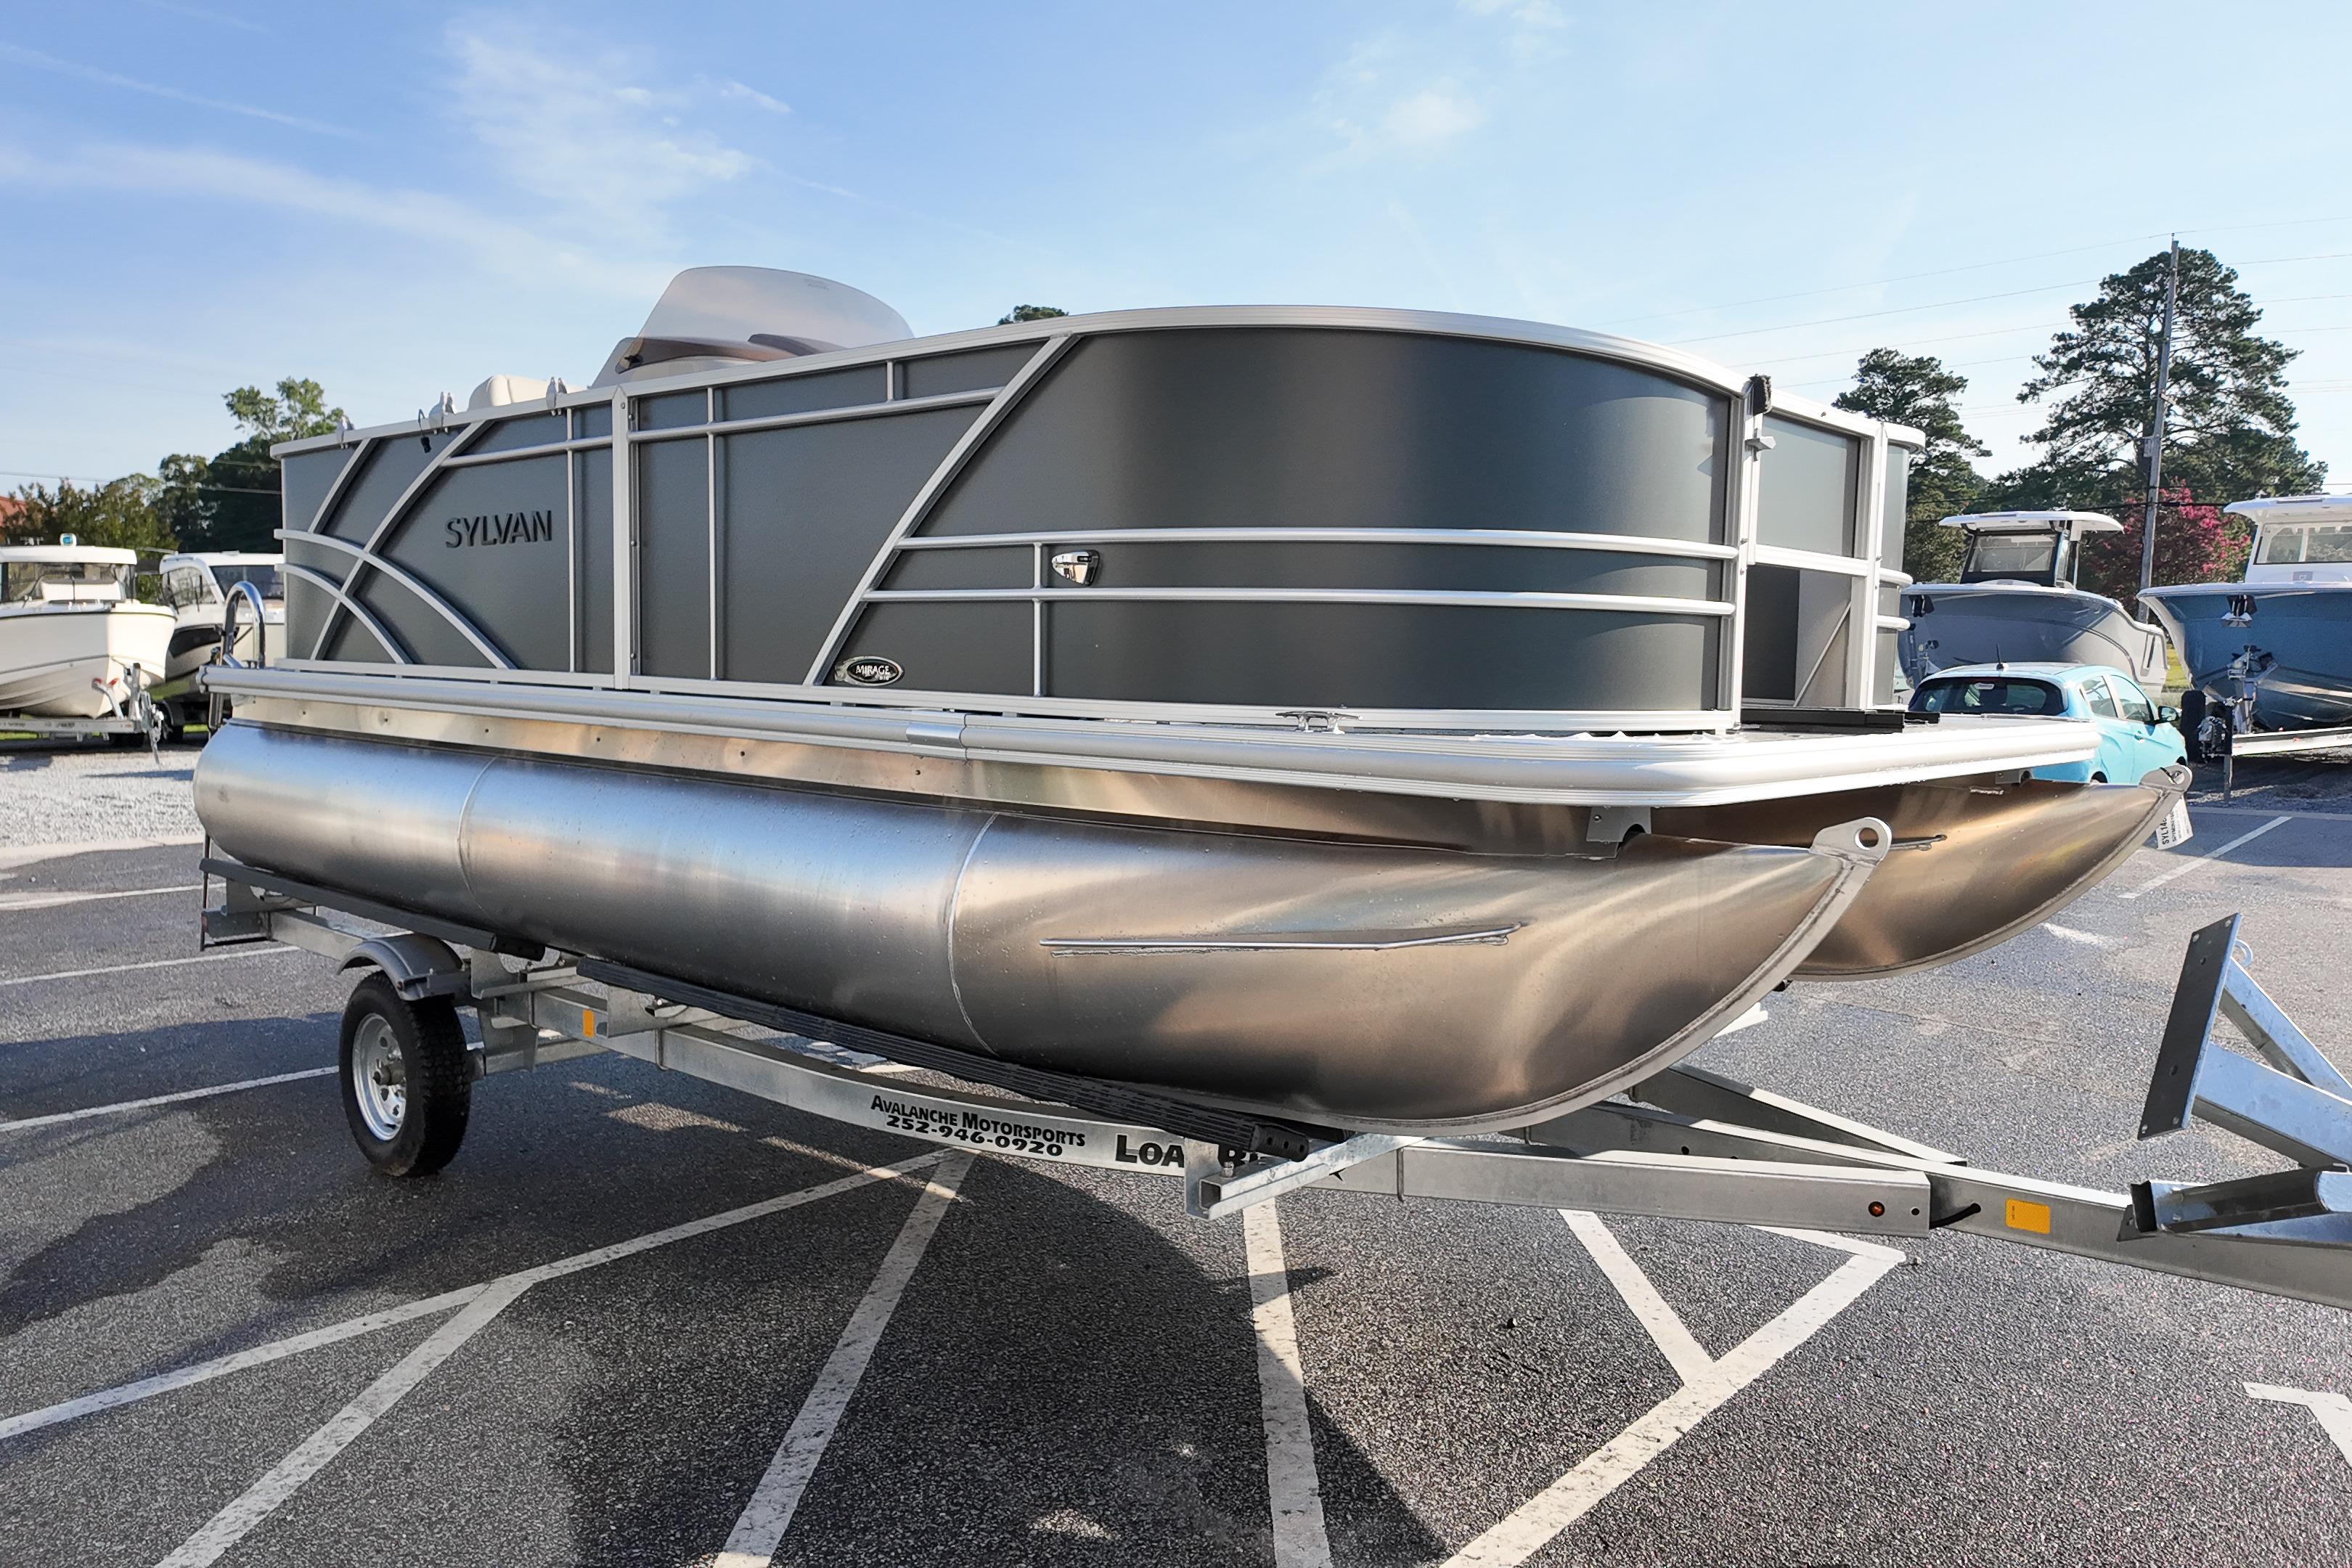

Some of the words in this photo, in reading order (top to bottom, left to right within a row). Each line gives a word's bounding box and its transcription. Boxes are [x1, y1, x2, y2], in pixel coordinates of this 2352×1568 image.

[445, 510, 552, 549] SYLVAN
[855, 665, 891, 676] MIRAGE
[886, 1114, 1063, 1157] 252-946-0920
[1116, 1134, 1185, 1168] LOA
